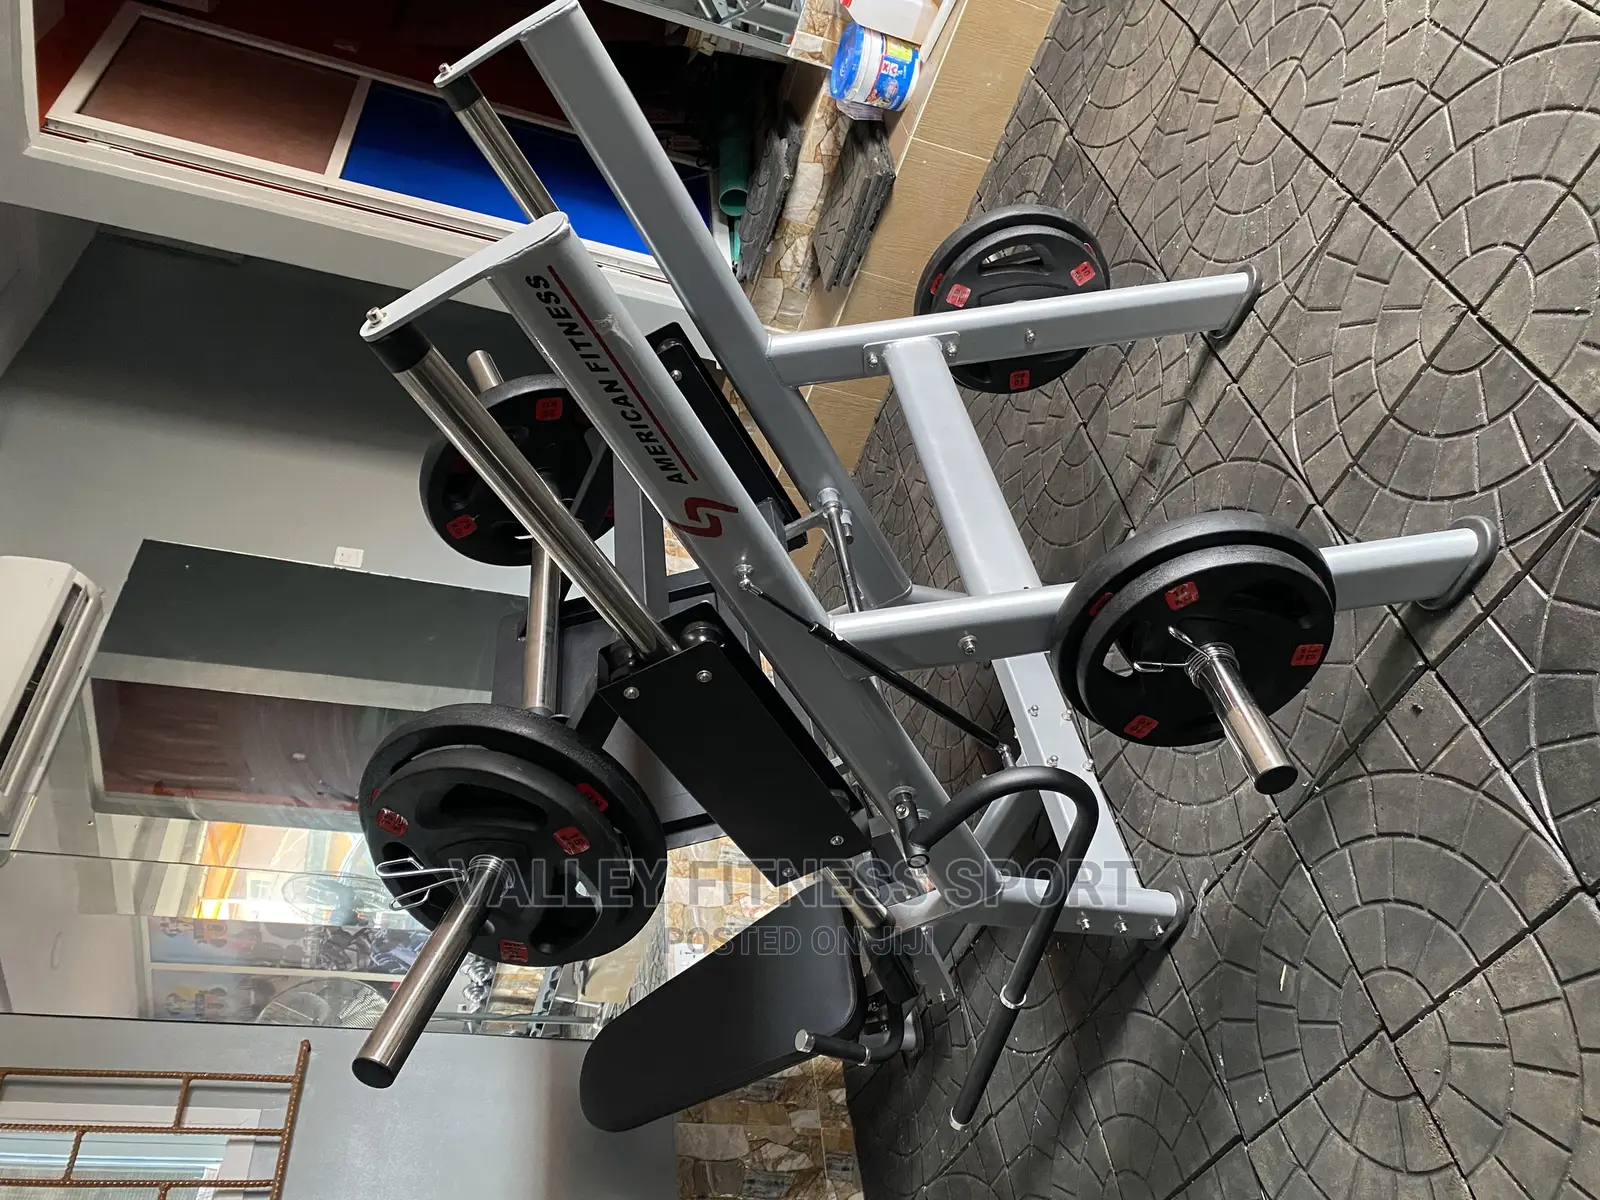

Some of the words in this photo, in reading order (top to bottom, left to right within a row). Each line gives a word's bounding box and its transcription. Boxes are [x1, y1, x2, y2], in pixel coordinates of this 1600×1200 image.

[1080, 264, 1091, 277] 10
[524, 274, 610, 373] FITNESS
[1013, 378, 1024, 387] 10
[598, 379, 689, 485] AMERICAN
